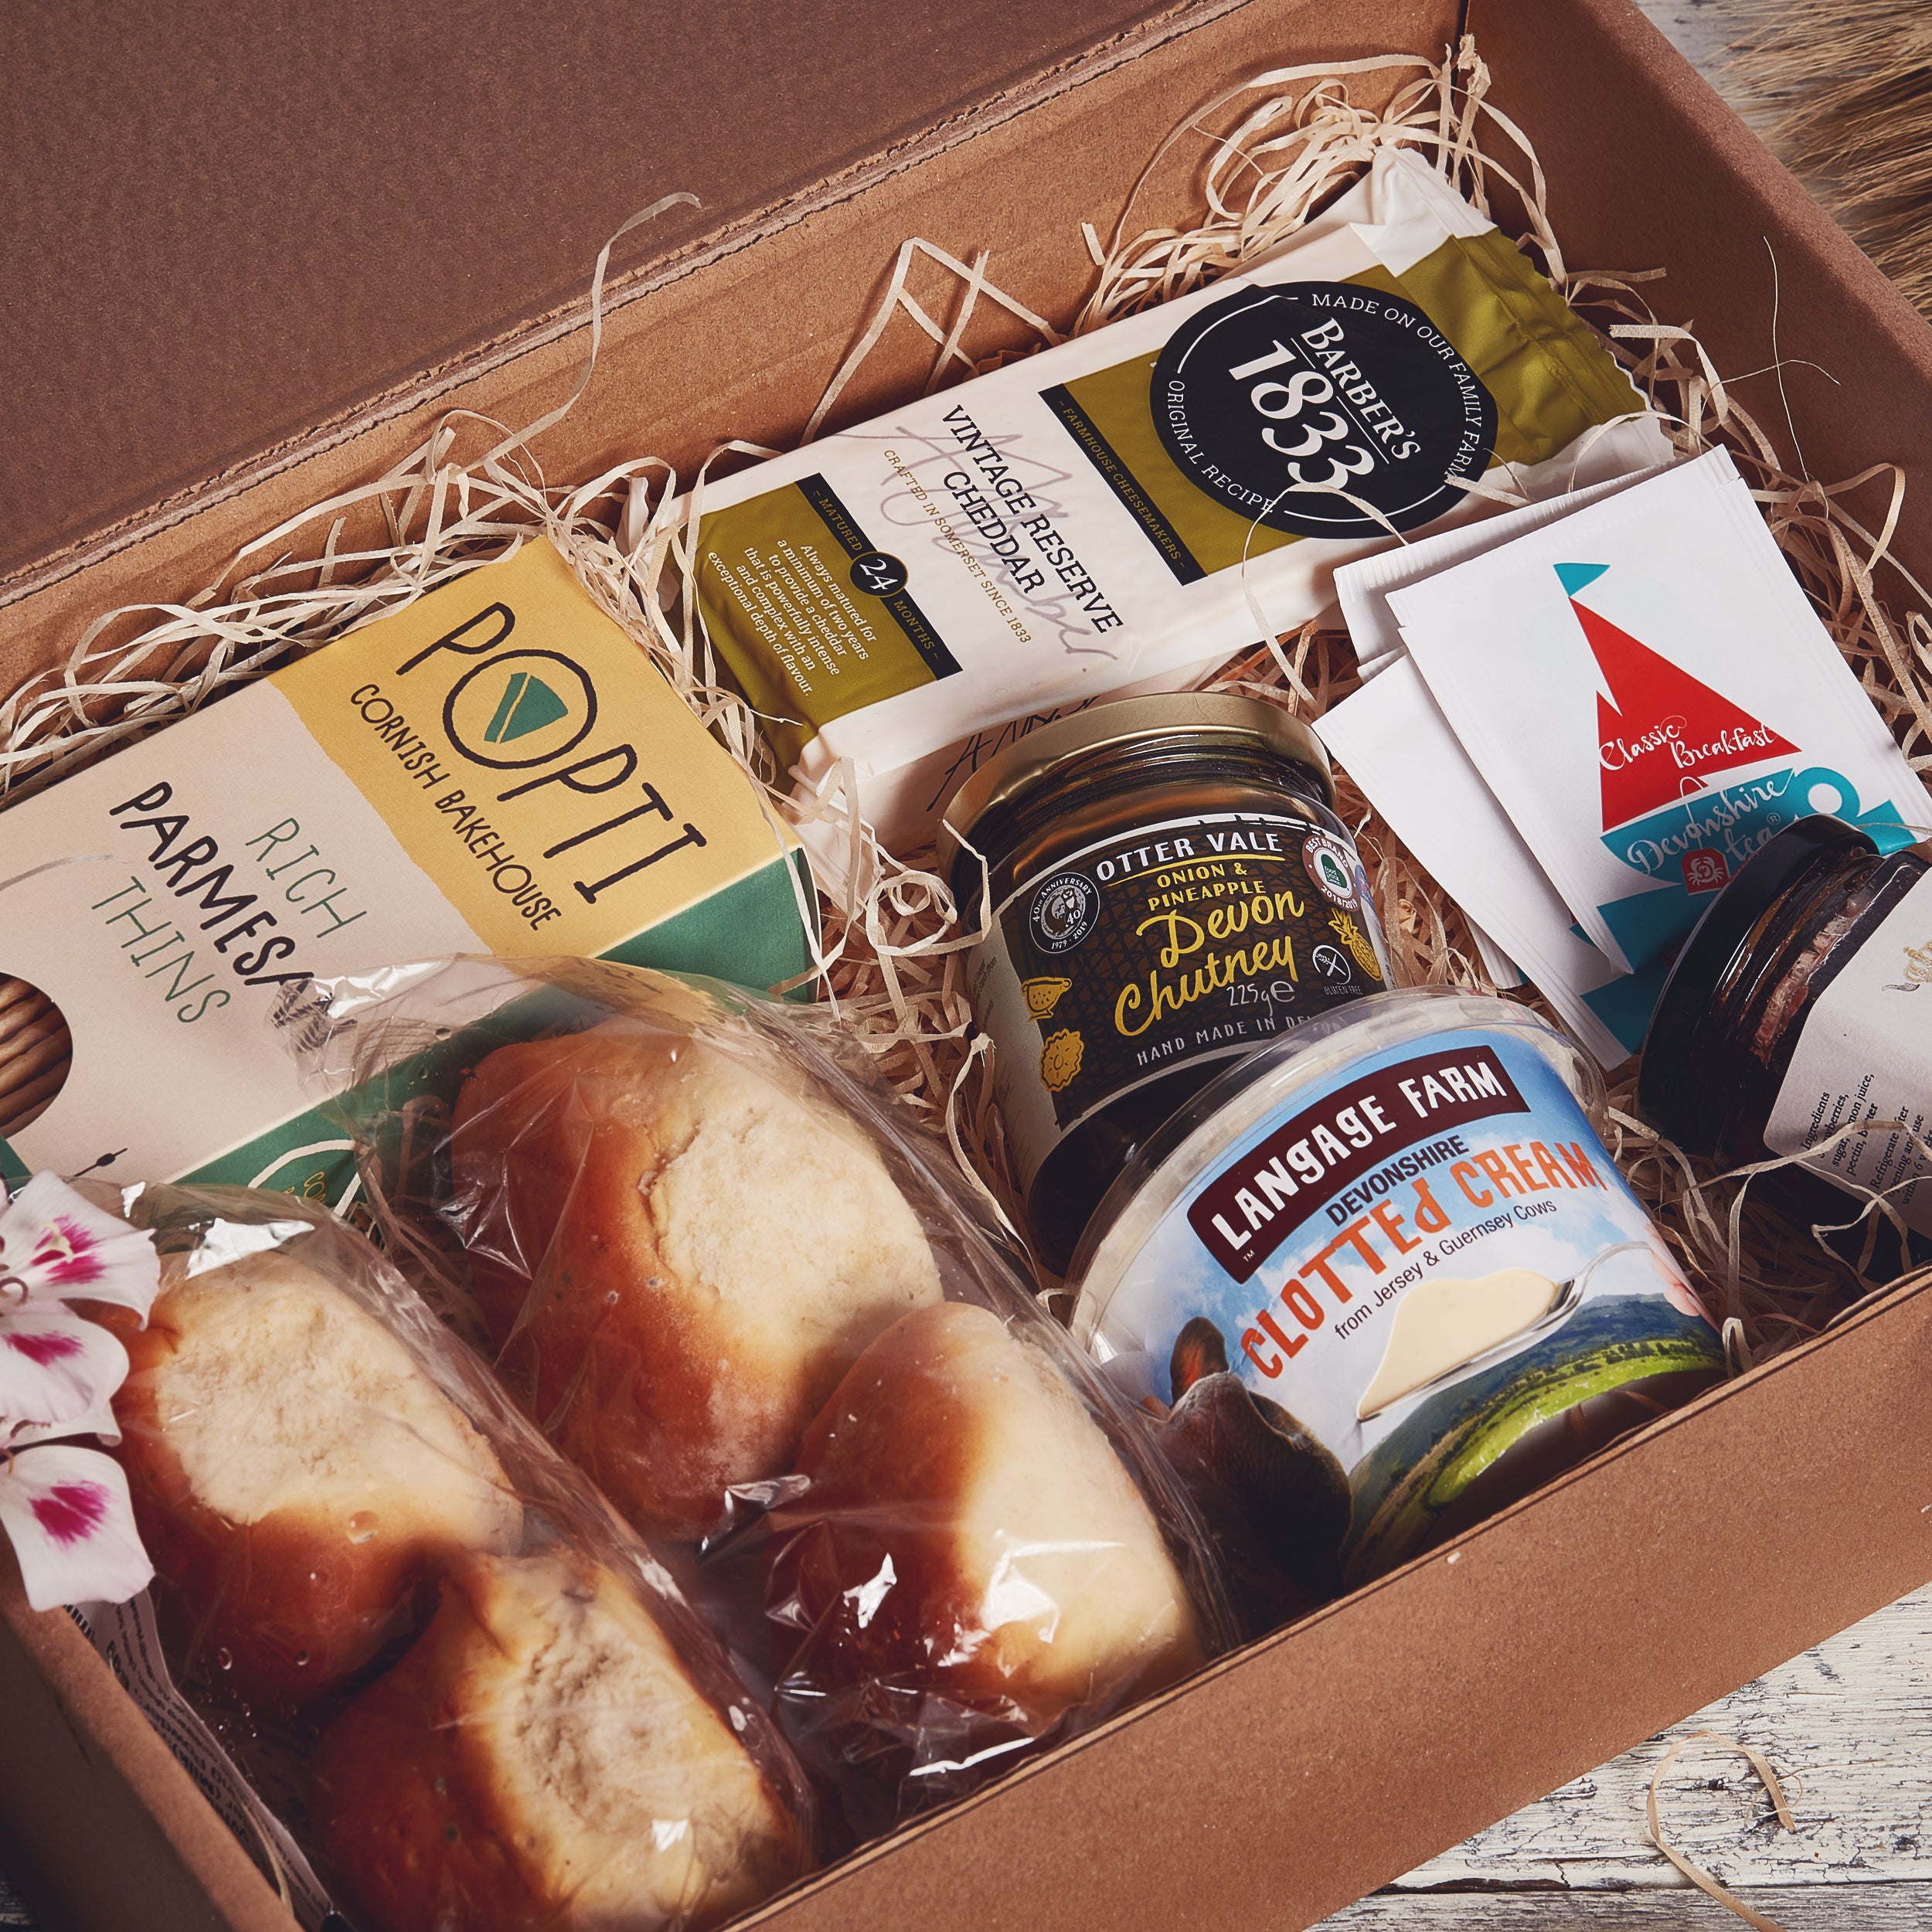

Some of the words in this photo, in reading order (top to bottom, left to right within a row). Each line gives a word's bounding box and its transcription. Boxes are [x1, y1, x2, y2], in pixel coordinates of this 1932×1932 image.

[1311, 294, 1379, 315] MADE
[1384, 308, 1416, 329] ON
[1417, 325, 1454, 362] OUR
[1228, 339, 1376, 492] 1833
[1301, 318, 1422, 461] BARBER'S
[1448, 361, 1482, 427] FAMILY
[1168, 379, 1199, 465] ORIGINAL
[1200, 465, 1277, 513] RECIPE
[1444, 430, 1481, 479] FARM
[1063, 408, 1117, 474] FARMHOUSE
[1112, 473, 1182, 561] CHEESEMAKERS
[941, 404, 1037, 516] VINTAGE
[1019, 513, 1124, 634] RESERVE
[943, 471, 1046, 595] CHEDDAR
[743, 547, 764, 571] that
[768, 554, 781, 568] to
[818, 498, 862, 552] MATURED
[859, 559, 898, 591] 24
[893, 600, 935, 651] MONTHS
[883, 449, 929, 503] CRAFTED
[922, 501, 941, 519] IN
[933, 515, 986, 580] SOMERSET
[980, 579, 1013, 617] SINCE
[1007, 611, 1032, 645] 1833
[707, 551, 754, 614] exceptional
[760, 568, 772, 583] is
[774, 563, 809, 612] provide
[777, 539, 787, 549] a
[783, 546, 824, 600] minimum
[820, 596, 836, 613] of
[828, 608, 849, 631] two
[842, 628, 869, 660] years
[801, 544, 832, 583] Always
[828, 582, 867, 628] matured
[859, 625, 877, 643] for
[736, 564, 757, 587] and
[751, 585, 788, 631] complex
[783, 628, 807, 655] with
[801, 654, 816, 672] an
[750, 611, 776, 645] depth
[765, 580, 814, 637] powerfully
[807, 606, 816, 615] a
[811, 611, 848, 656] cheddar
[772, 641, 789, 658] of
[780, 649, 812, 697] flavour.
[807, 632, 841, 676] intense
[396, 601, 707, 904] POPTI
[1598, 715, 1687, 770] Classic
[1669, 724, 1781, 770] Breakfast
[350, 683, 451, 790] CORNISH
[434, 789, 563, 931] BAKEHOUSE
[1627, 770, 1794, 875] Devonshire
[245, 818, 367, 938] RICH
[1096, 838, 1196, 882] OTTER
[1206, 832, 1284, 855] VALE
[1156, 862, 1226, 888] ONION
[1233, 862, 1248, 875] &
[1305, 837, 1322, 854] BEST
[1321, 835, 1349, 869] BRAND
[1041, 877, 1093, 898] ANNIVERSARY
[1147, 879, 1267, 912] PINEAPPLE
[1321, 886, 1359, 910] 2018/2019
[1051, 940, 1067, 950] 1979
[1073, 921, 1088, 940] 2019
[1066, 910, 1081, 925] 40
[1135, 888, 1305, 969] Devon
[91, 876, 231, 1024] THINS
[1114, 934, 1300, 1037] Chutney
[1324, 985, 1349, 995] GLUTEN
[1349, 985, 1363, 995] FREE
[1137, 1037, 1185, 1066] HAND
[1196, 1021, 1248, 1045] MADE
[1256, 1017, 1276, 1032] IN
[1397, 1061, 1508, 1118] FARM
[1800, 1091, 1831, 1151] Ingredients
[1832, 1137, 1851, 1167] sugar,
[1855, 1073, 1875, 1103] juice,
[1912, 1114, 1924, 1133] use
[1325, 1134, 1470, 1227] DEVONSHIRE
[1449, 1140, 1608, 1209] CREAM
[1846, 1139, 1866, 1177] pectin,
[1870, 1131, 1900, 1189] Refrigerate
[1913, 1162, 1923, 1171] 6
[1335, 1303, 1374, 1342] from
[1372, 1262, 1427, 1309] Jersey
[1423, 1249, 1441, 1267] &
[1438, 1214, 1515, 1257] Guernsey
[1512, 1198, 1557, 1223] Cows
